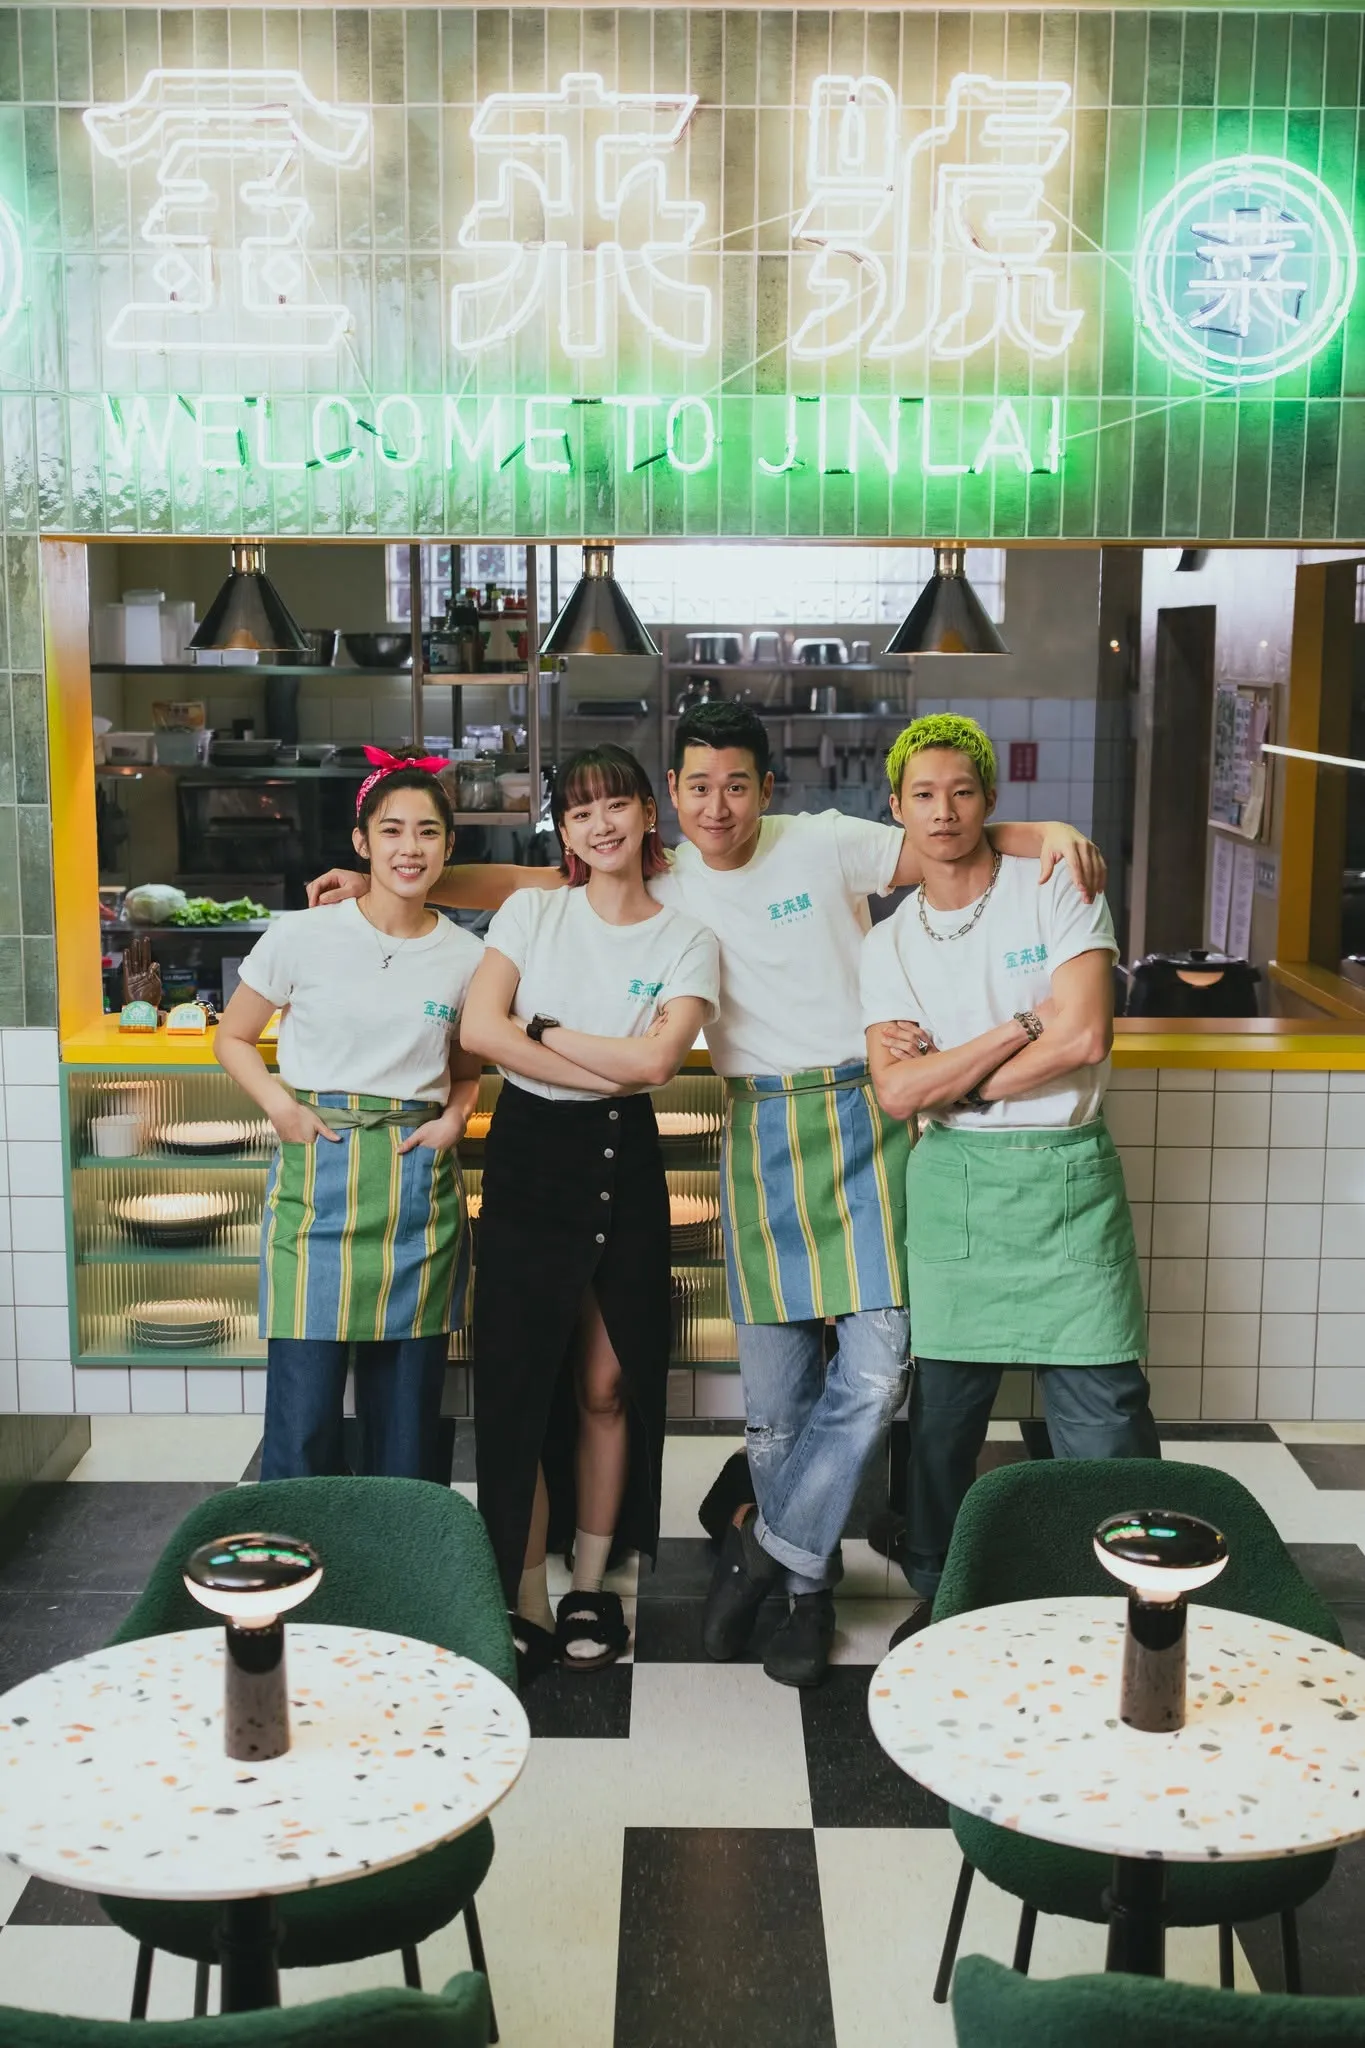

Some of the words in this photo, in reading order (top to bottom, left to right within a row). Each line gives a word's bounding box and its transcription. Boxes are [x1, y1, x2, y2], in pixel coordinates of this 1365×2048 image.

[1188, 206, 1309, 338] 菜
[102, 393, 573, 473] WELCOME
[601, 394, 715, 473] TO
[758, 394, 1060, 475] JINLAI
